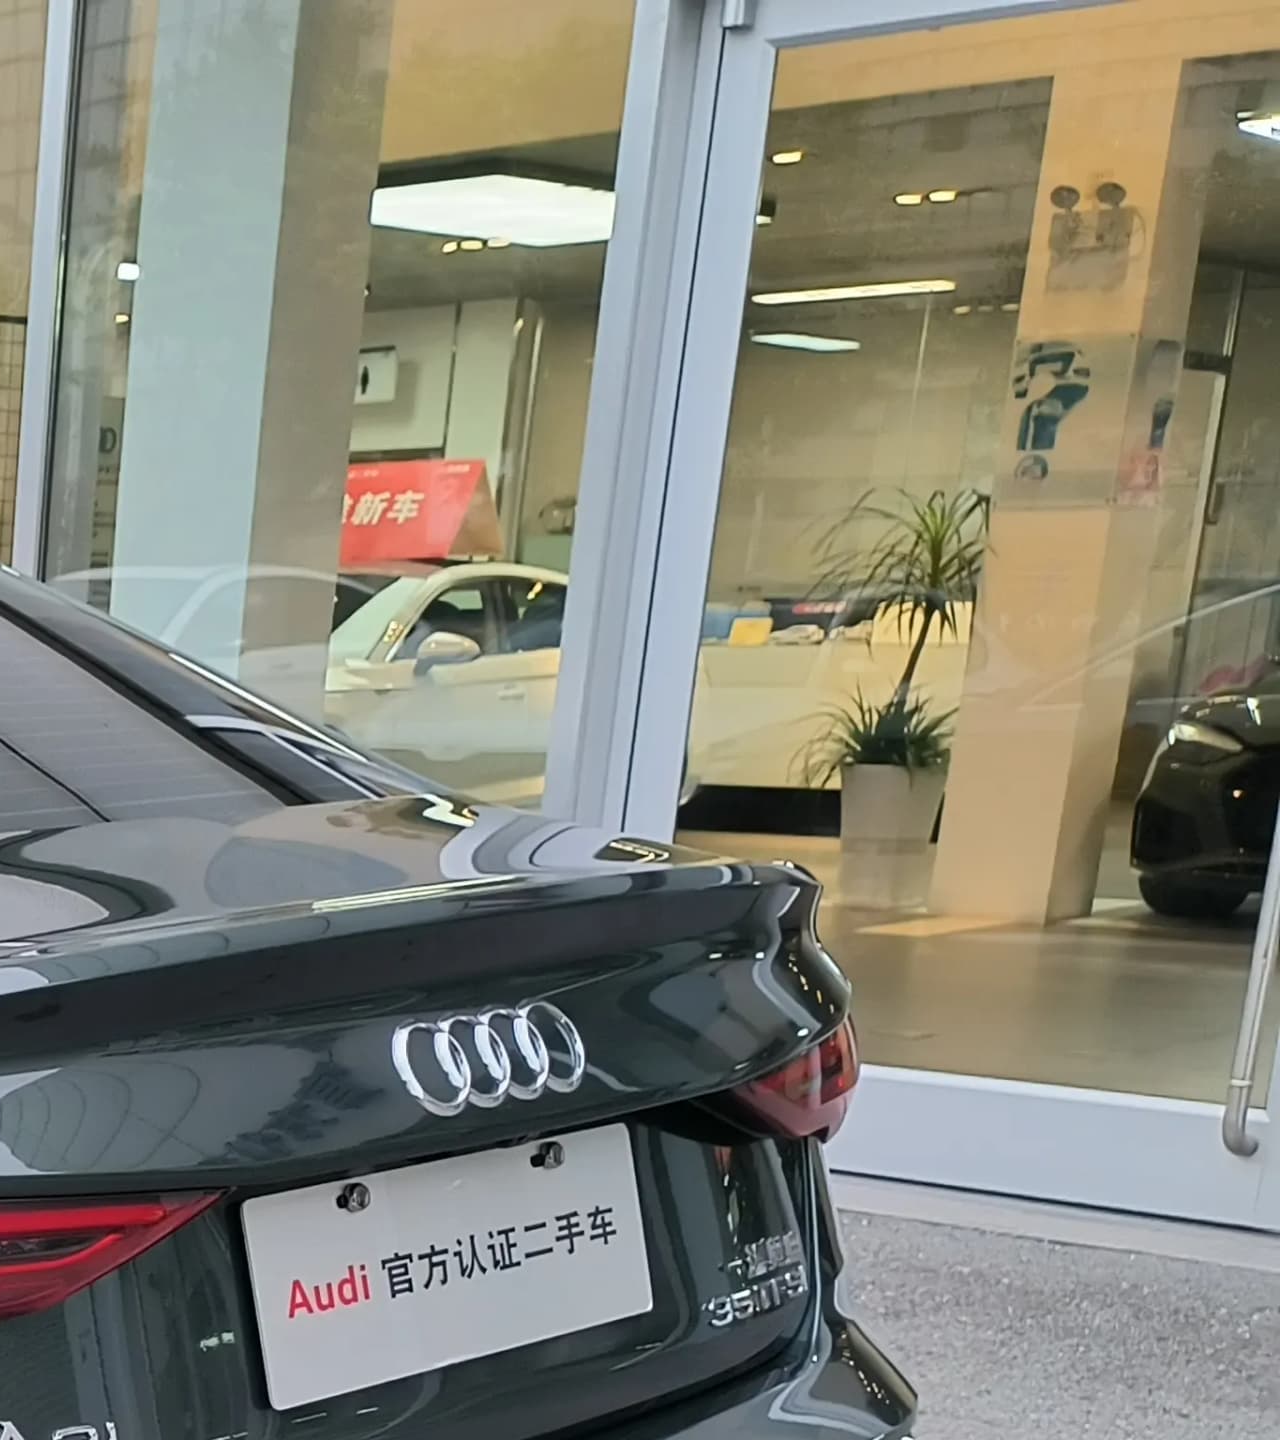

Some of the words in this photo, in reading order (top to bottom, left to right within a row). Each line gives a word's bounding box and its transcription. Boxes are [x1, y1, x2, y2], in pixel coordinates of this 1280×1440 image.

[289, 1263, 371, 1318] Audi
[380, 1205, 617, 1299] 官方认证二手车
